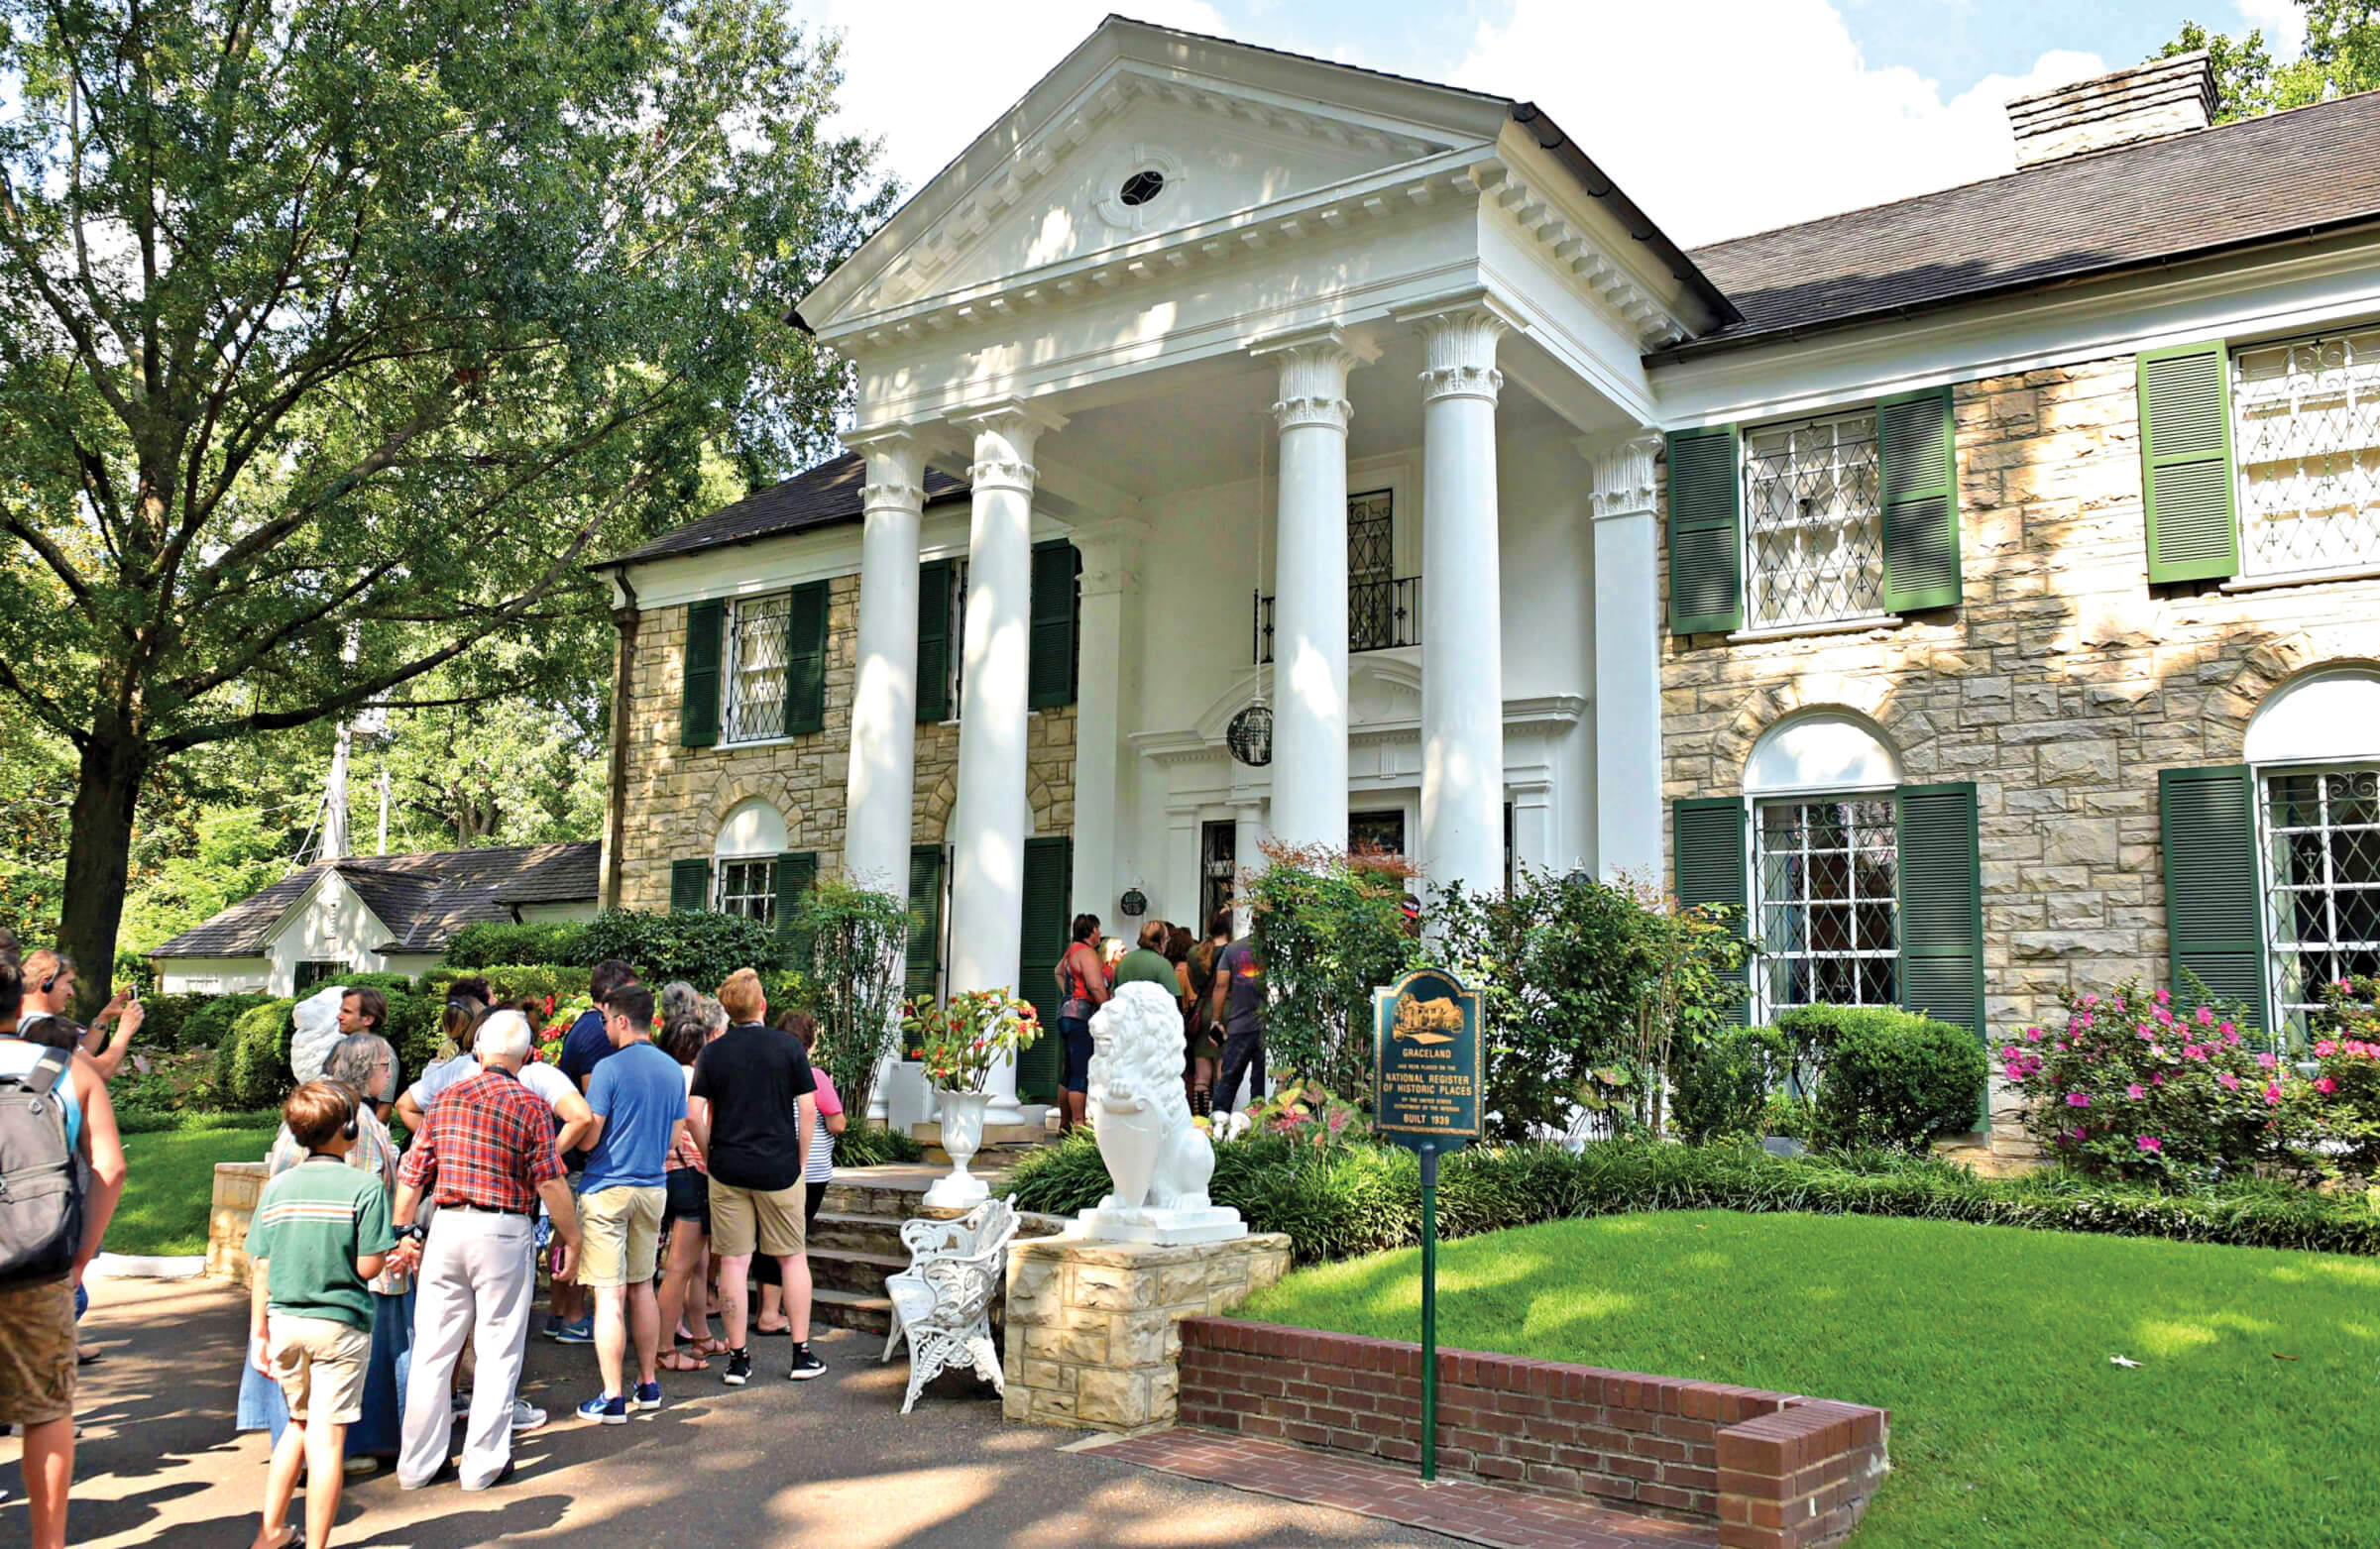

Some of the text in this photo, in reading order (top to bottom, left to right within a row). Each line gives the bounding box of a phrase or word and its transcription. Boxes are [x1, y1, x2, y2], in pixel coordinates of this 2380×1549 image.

[1403, 1049, 1451, 1058] GRACELAND
[1386, 1073, 1469, 1085] NATIONAL REGISTER
[1383, 1083, 1472, 1095] OF HISTORIC PLACES
[1404, 1113, 1425, 1123] BUILT
